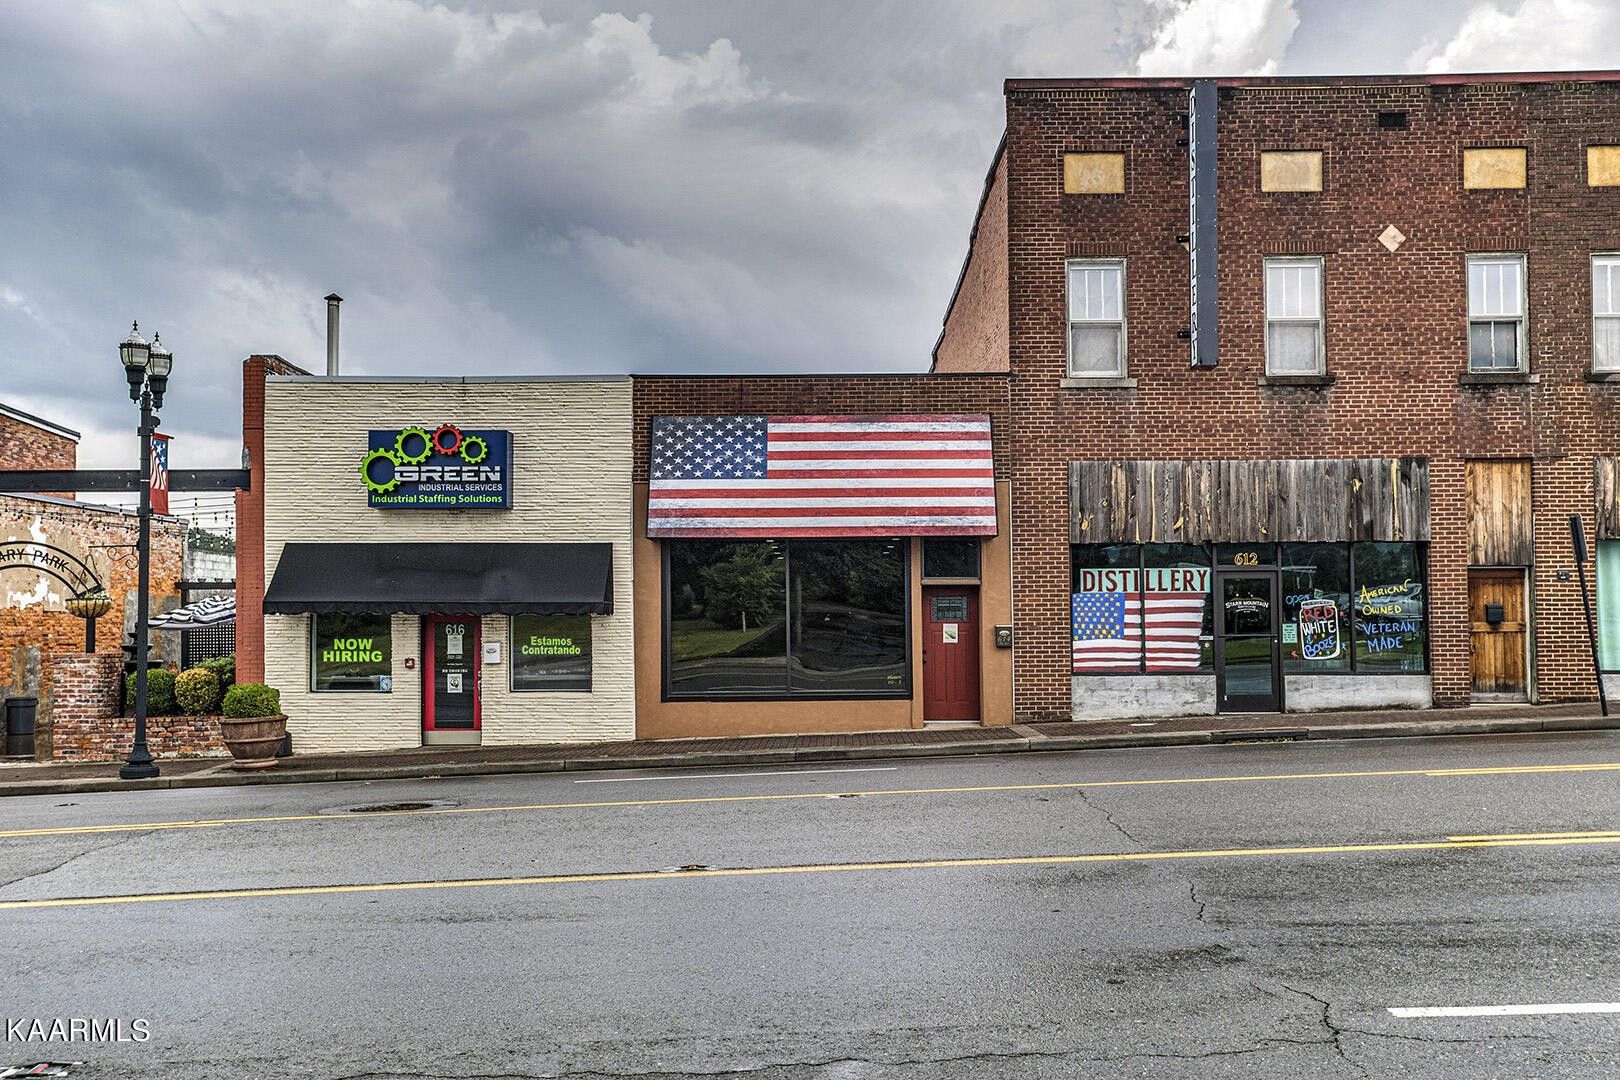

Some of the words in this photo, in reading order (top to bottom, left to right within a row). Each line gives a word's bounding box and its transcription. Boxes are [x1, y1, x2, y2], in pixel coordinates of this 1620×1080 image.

[394, 465, 501, 481] GREEN
[418, 483, 464, 491] INDUSTRIAL
[465, 483, 503, 491] SERVICES
[372, 494, 417, 503] Industrial
[419, 494, 457, 505] Staffing
[458, 494, 503, 503] Solutions
[33, 549, 70, 573] PARK
[1234, 552, 1258, 566] 612
[1082, 569, 1208, 593] DISTILLERY
[1303, 605, 1335, 622] RED
[446, 624, 465, 635] 616
[1362, 621, 1416, 635] VETERAN
[333, 638, 373, 650] NOW
[530, 636, 573, 646] Estamos
[1304, 635, 1337, 657] BOOZE
[1367, 636, 1404, 654] MADE
[323, 651, 383, 662] HIRING
[521, 645, 581, 655] Contratando
